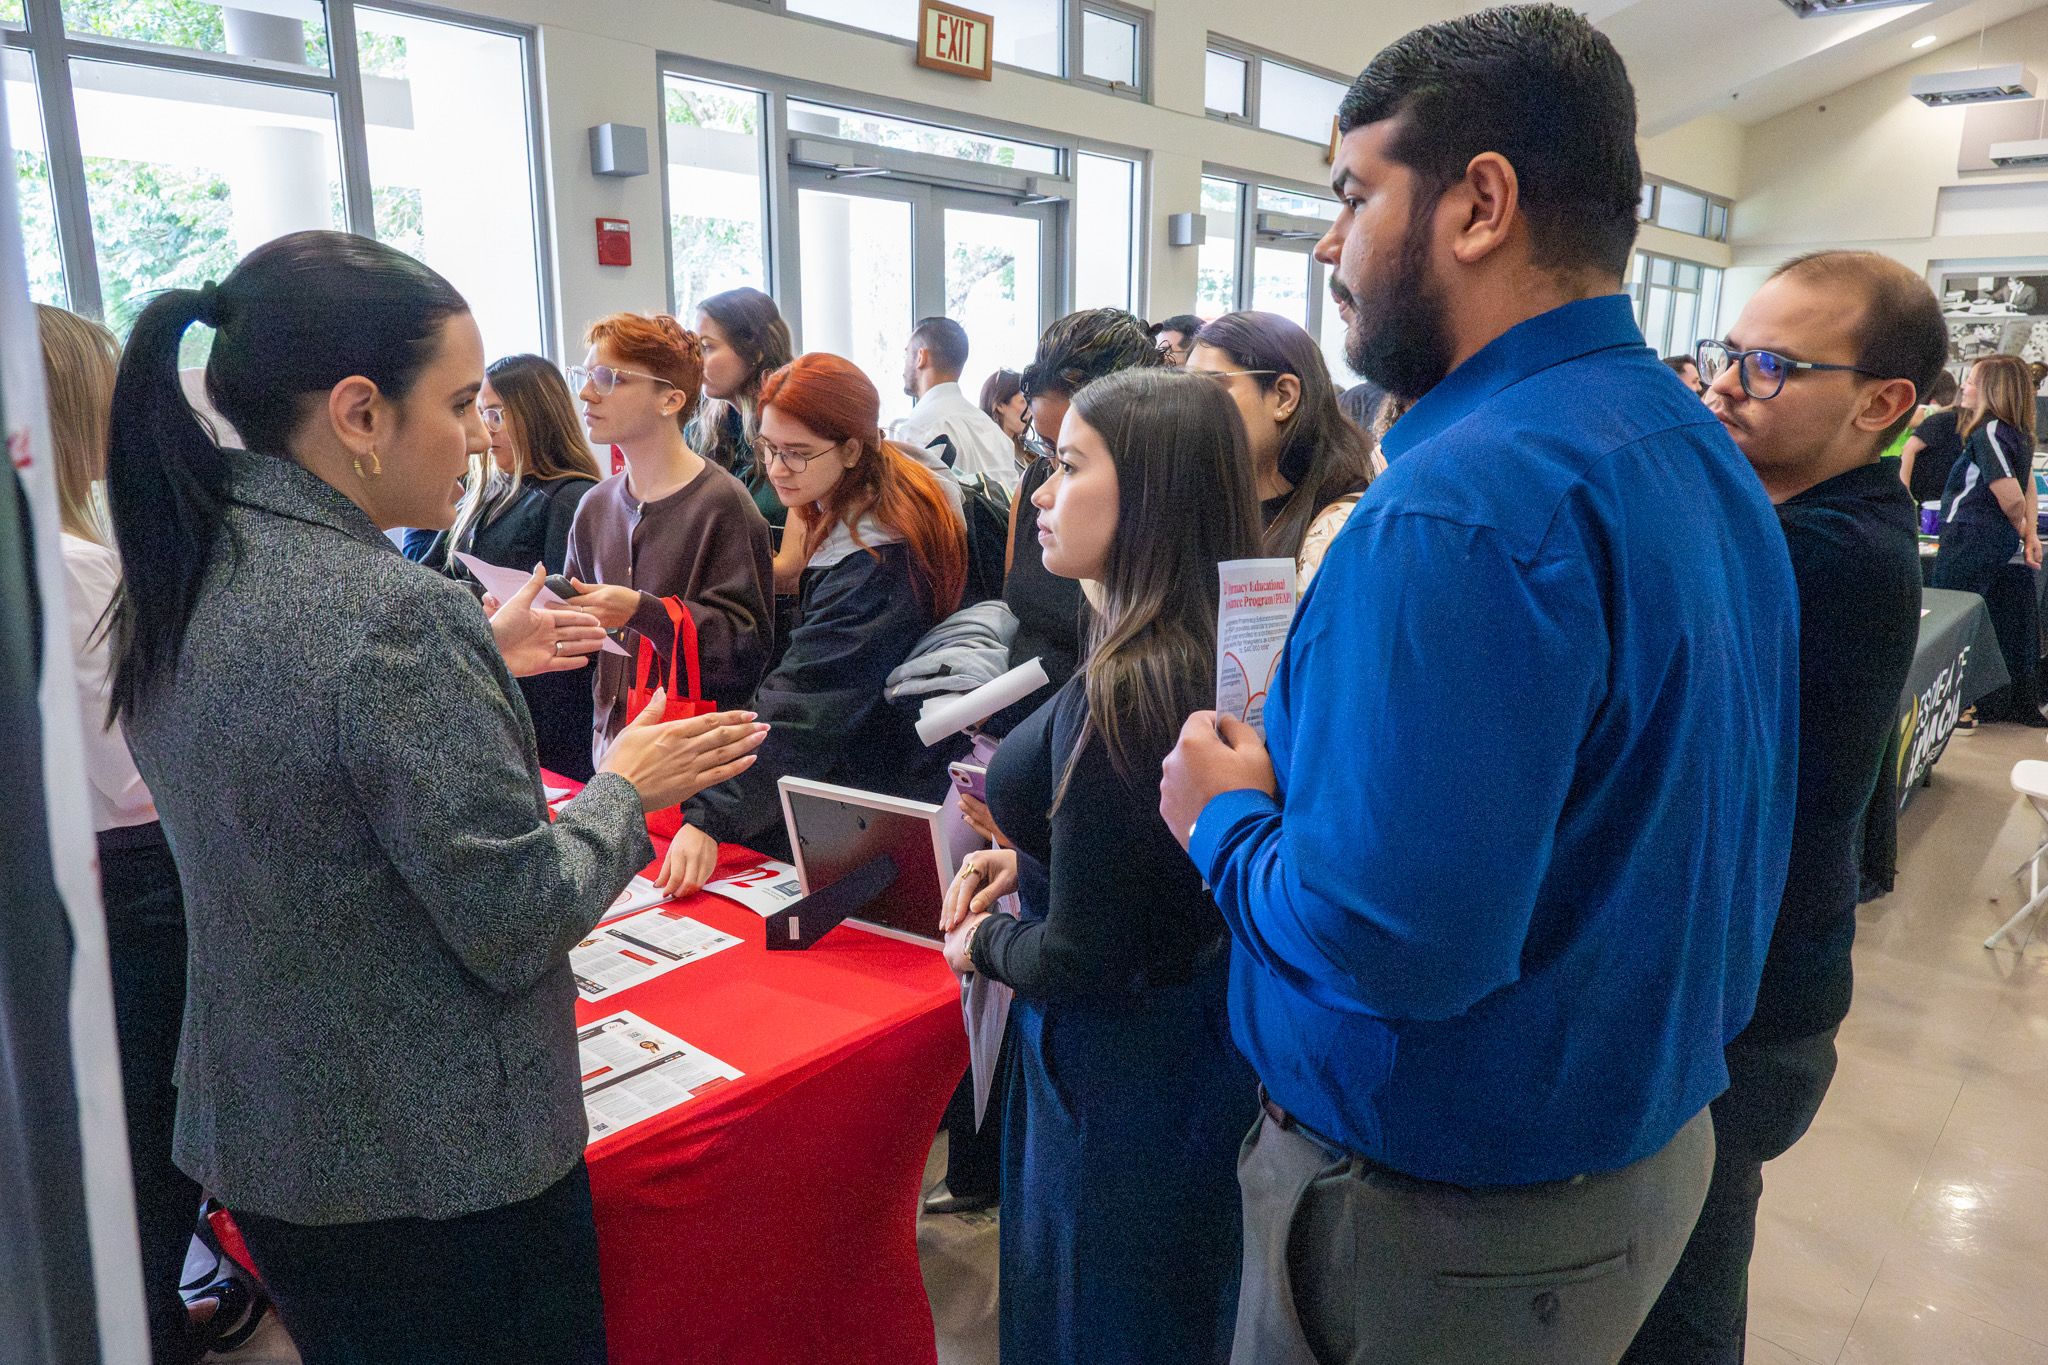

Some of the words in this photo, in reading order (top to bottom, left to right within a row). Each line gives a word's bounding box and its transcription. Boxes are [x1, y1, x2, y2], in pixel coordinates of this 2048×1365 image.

[936, 13, 974, 64] EXIT
[1249, 577, 1285, 592] Educational
[1244, 595, 1273, 607] Program
